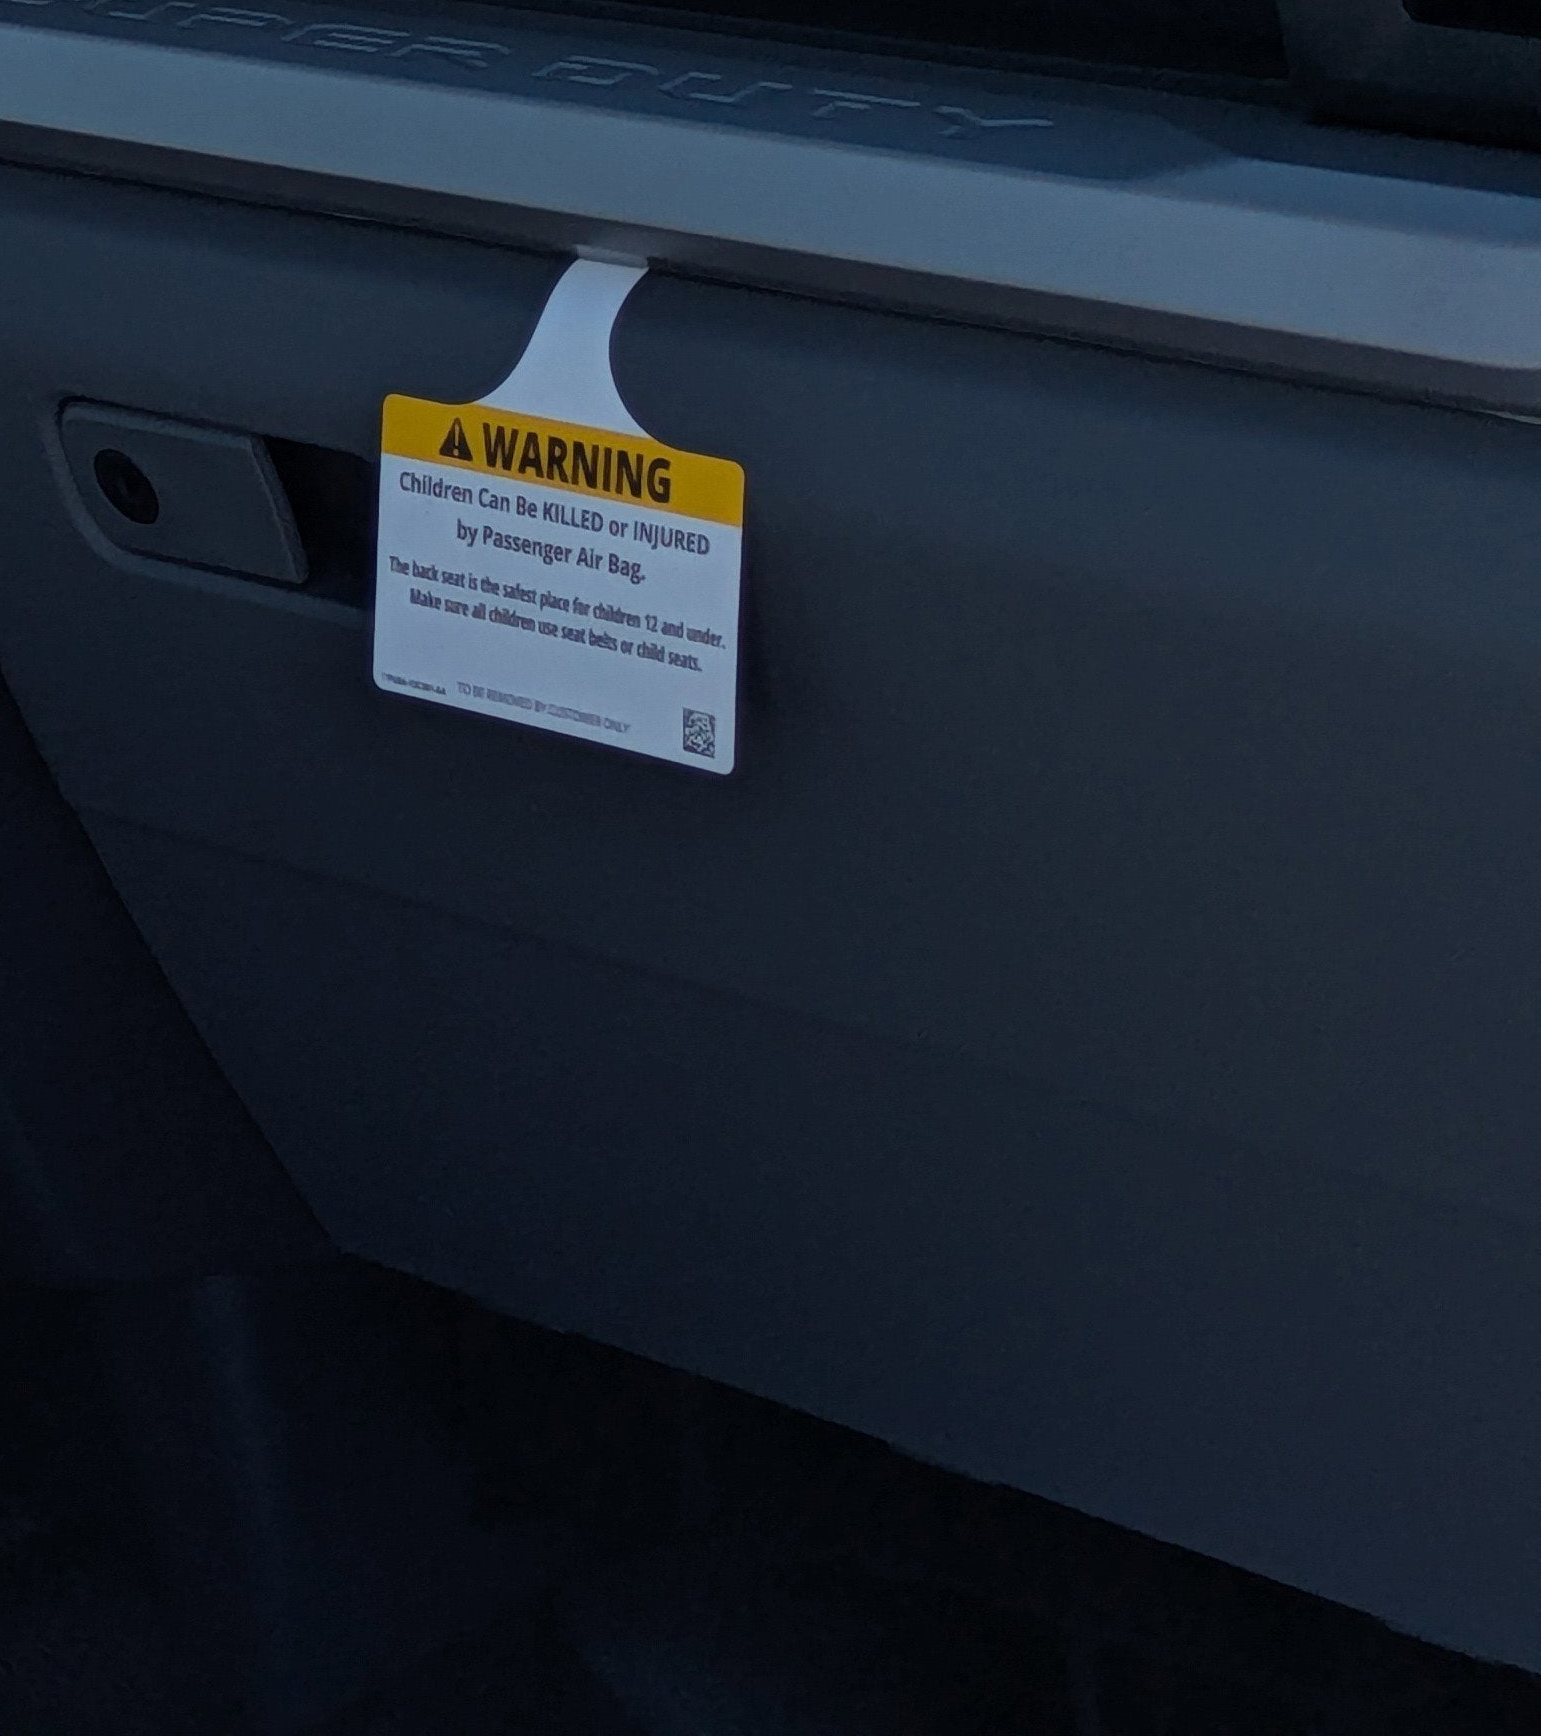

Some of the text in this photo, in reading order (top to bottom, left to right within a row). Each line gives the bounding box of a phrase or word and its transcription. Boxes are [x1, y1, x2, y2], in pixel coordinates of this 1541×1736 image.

[529, 54, 1056, 140] DUTY
[482, 421, 672, 504] WARNING
[399, 470, 711, 556] Children Can Be KILLED or INJURED
[456, 517, 647, 586] by Passenger Air Bag.
[389, 555, 727, 650] The back seat is the safest place for children 12 and under.
[409, 587, 442, 610] Make
[444, 598, 470, 617] sure
[471, 602, 487, 621] all
[489, 606, 536, 633] children
[538, 620, 559, 638] use
[561, 625, 587, 645] seat
[620, 639, 635, 655] or
[636, 641, 666, 663] child
